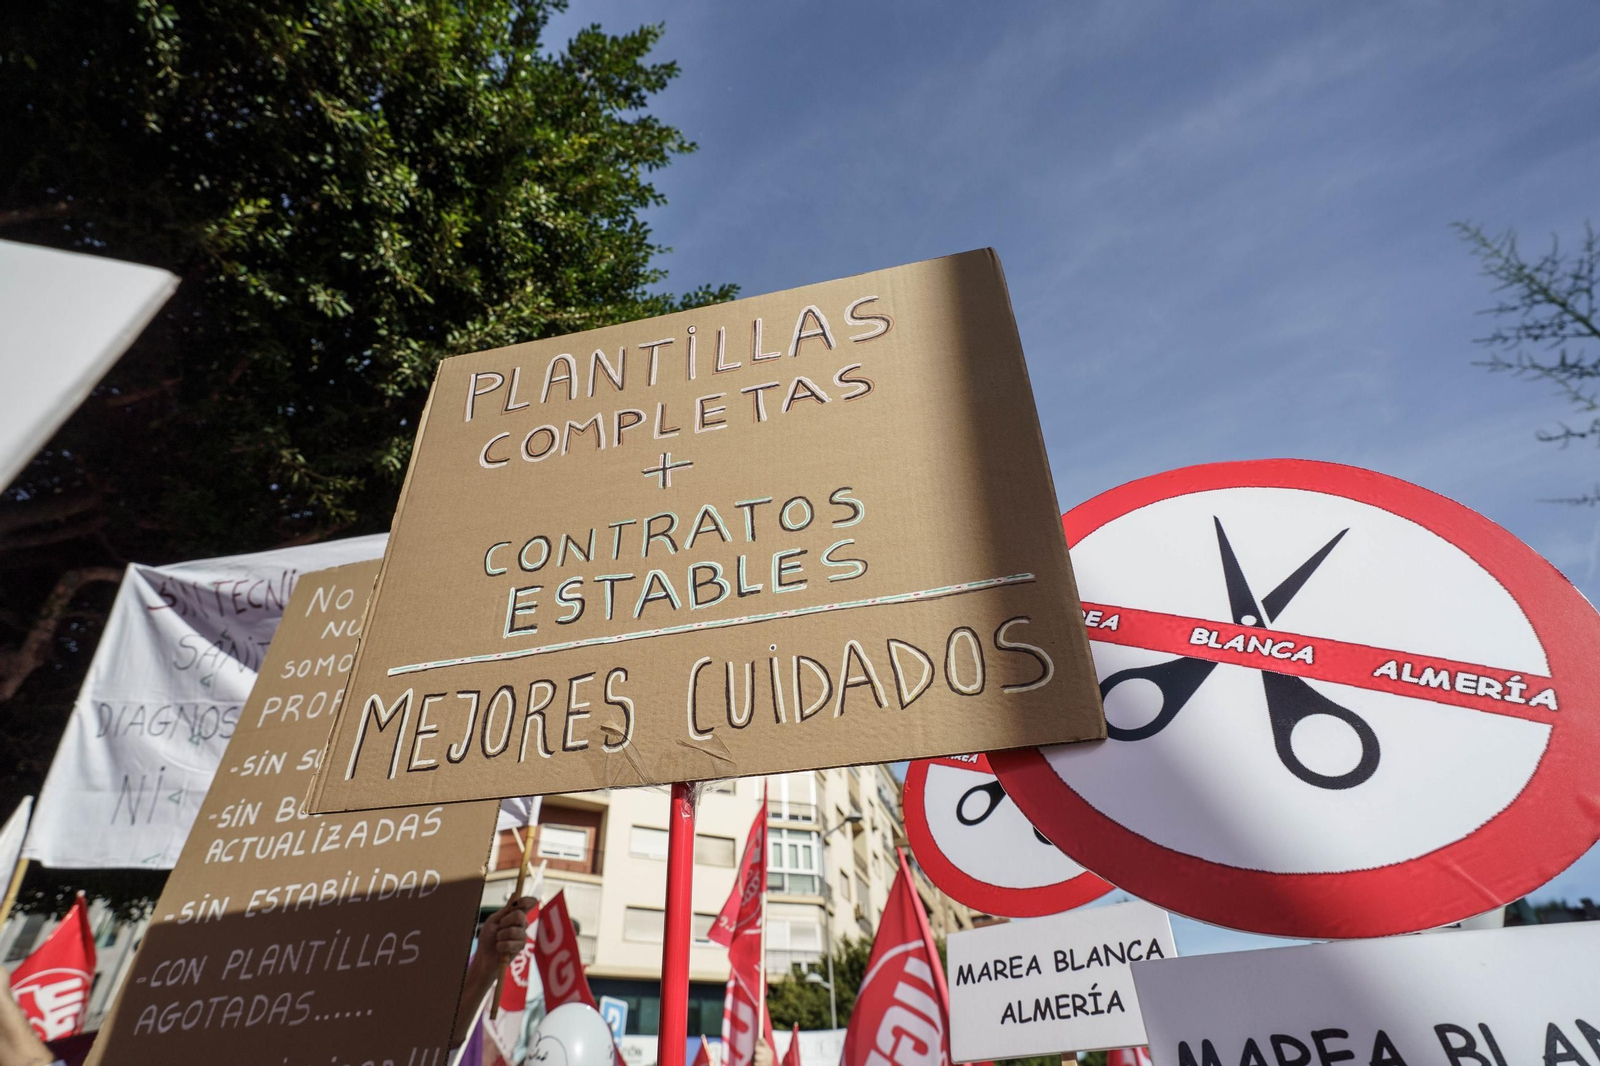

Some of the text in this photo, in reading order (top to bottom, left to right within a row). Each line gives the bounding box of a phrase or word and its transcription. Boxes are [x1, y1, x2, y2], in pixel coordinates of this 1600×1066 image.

[479, 363, 875, 468] COMPLETAS
[484, 487, 865, 576] CONTRATOS
[305, 585, 354, 617] NO
[503, 539, 868, 638] ESTABLES
[1082, 610, 1558, 711] EA BLANCA ALMERÍA
[345, 667, 634, 780] MEJORES
[956, 938, 1164, 986] MAREA BLANCA
[1001, 983, 1125, 1025] ALMERÍA
